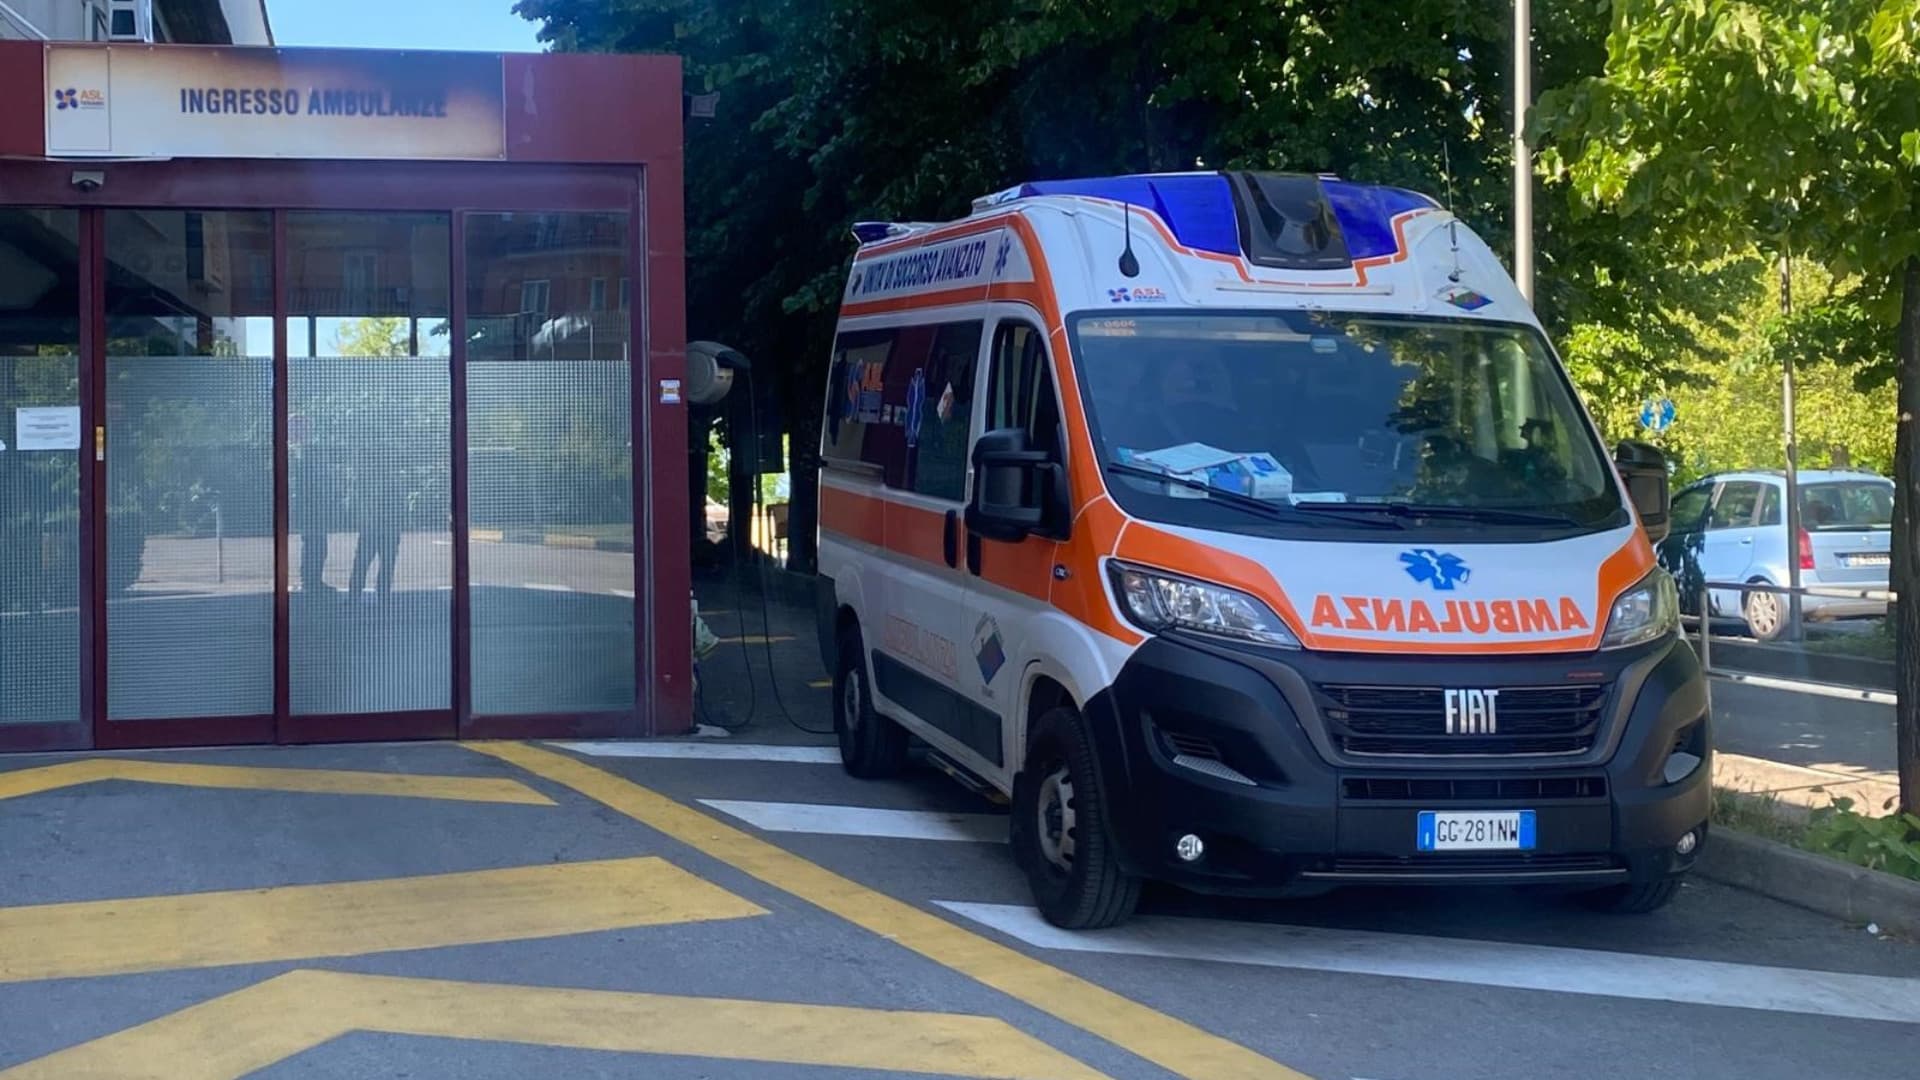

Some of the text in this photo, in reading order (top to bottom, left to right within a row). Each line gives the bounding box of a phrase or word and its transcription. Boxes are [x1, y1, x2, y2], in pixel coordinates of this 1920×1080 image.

[80, 89, 104, 100] ASL
[180, 88, 447, 118] INGRESSO AMBULANZE
[892, 249, 939, 290] SOCCORSO
[933, 239, 986, 282] AVANZATO
[1133, 287, 1164, 297] ASL
[1444, 689, 1499, 734] FIAT
